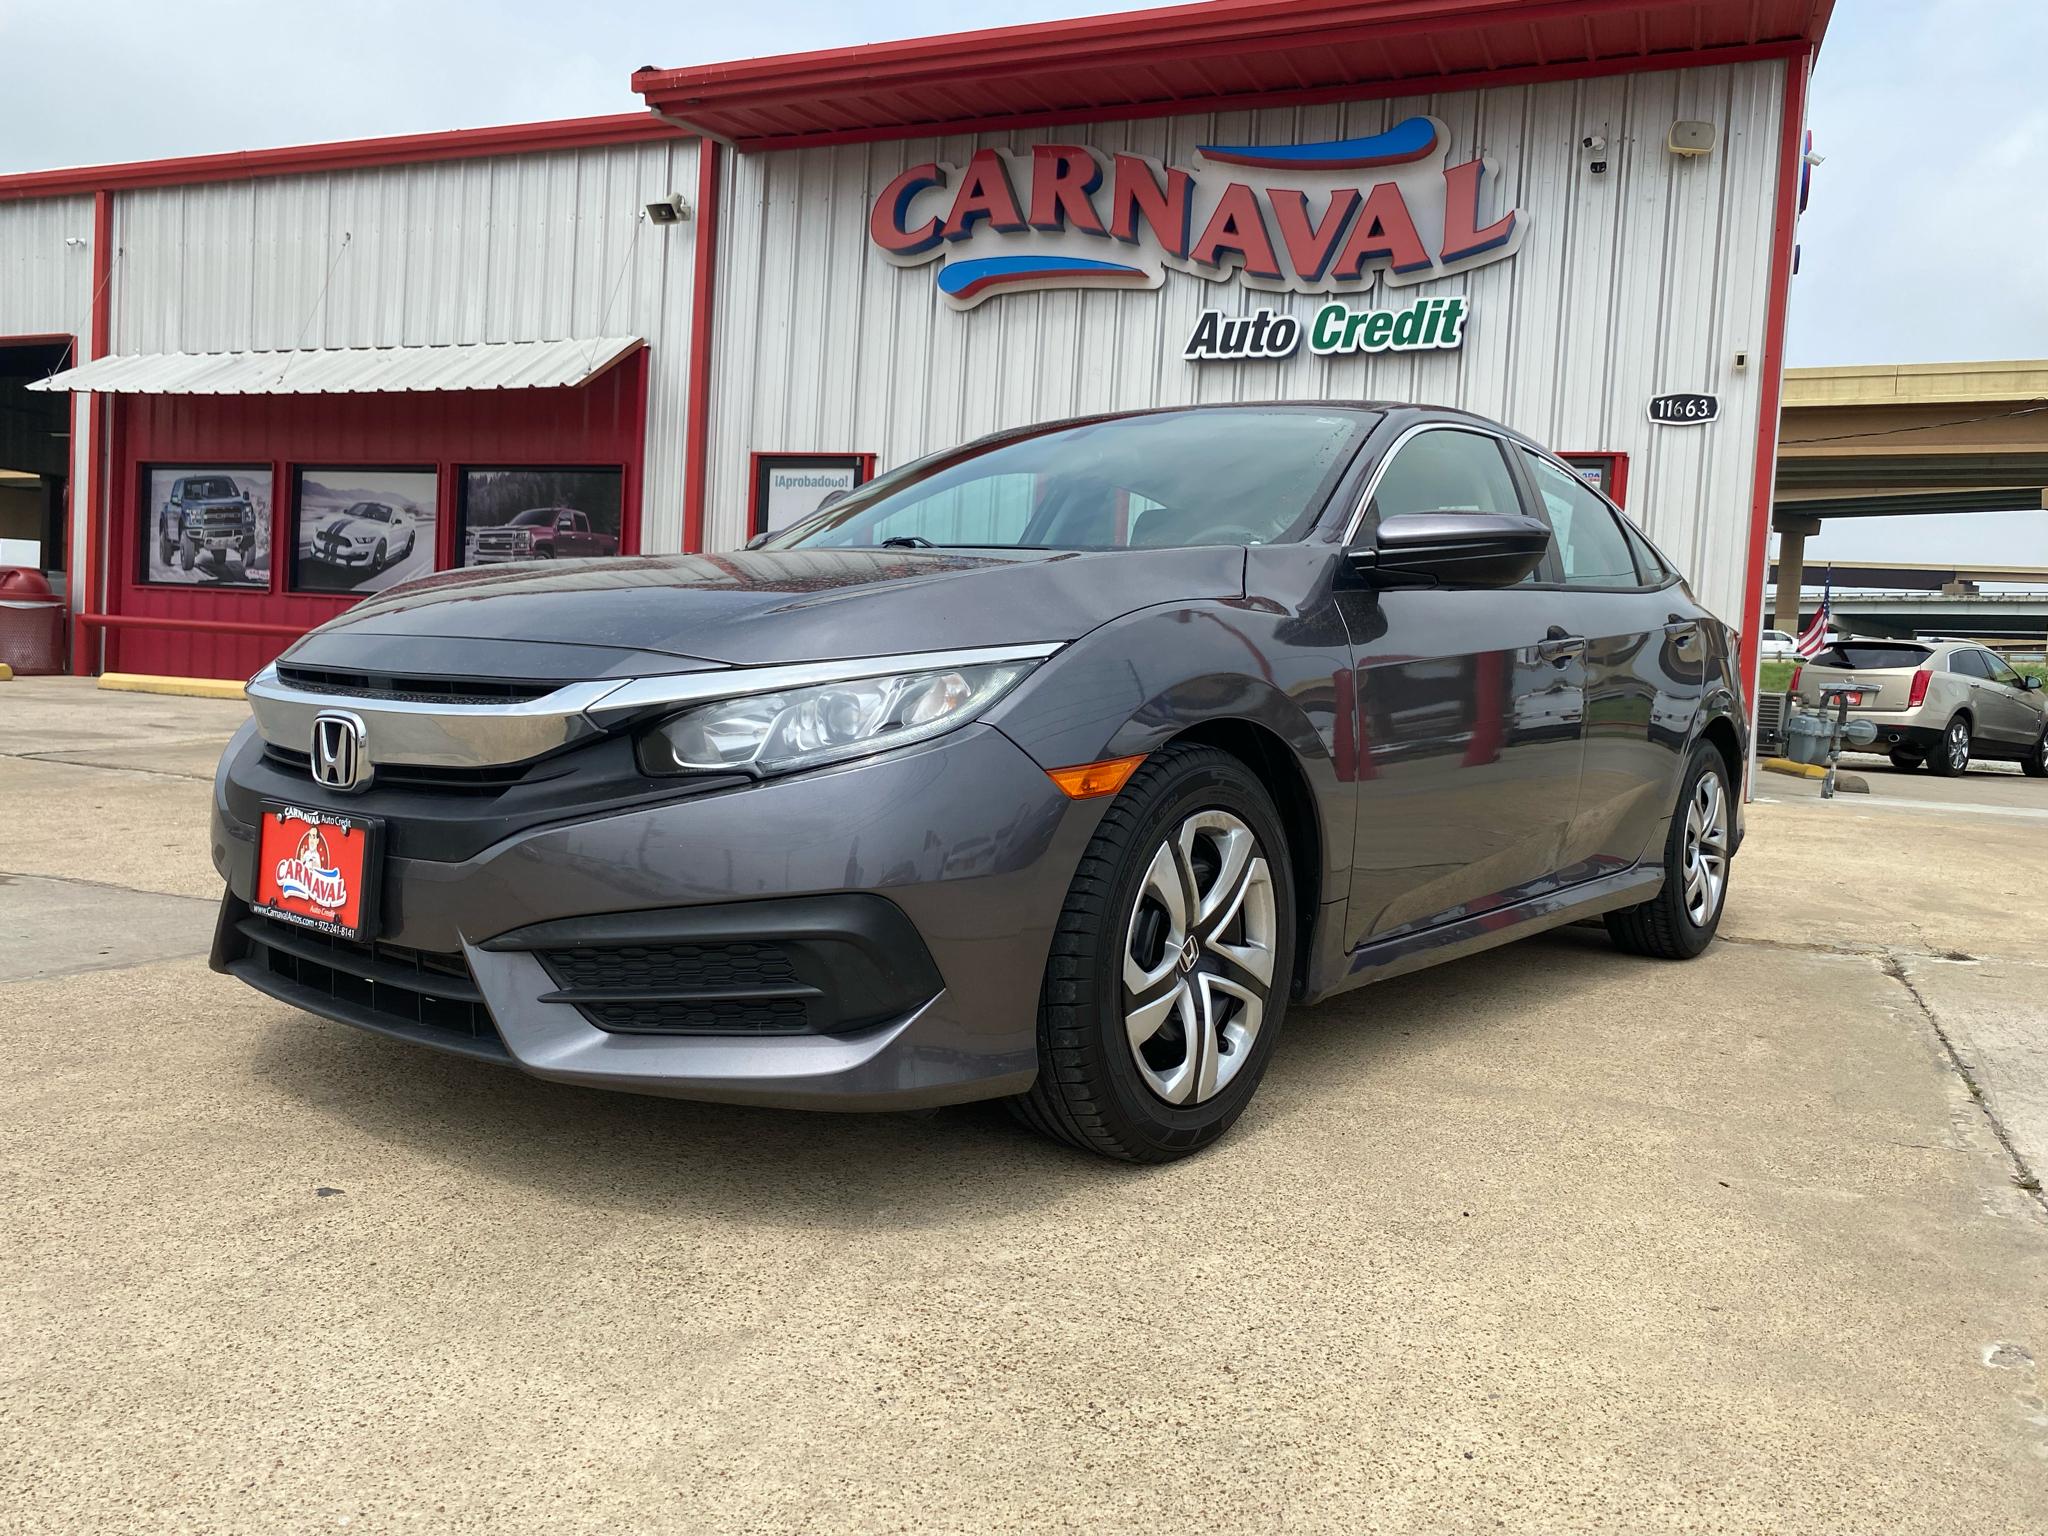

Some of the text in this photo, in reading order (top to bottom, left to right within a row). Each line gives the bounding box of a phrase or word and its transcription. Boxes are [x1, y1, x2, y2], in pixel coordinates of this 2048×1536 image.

[870, 144, 1515, 282] CARNAVAL
[1187, 298, 1463, 360] Auto Credit
[1658, 399, 1708, 418] 11663
[284, 806, 351, 828] CARNAVAL Auto Credit
[276, 860, 346, 903] CARNAVAL
